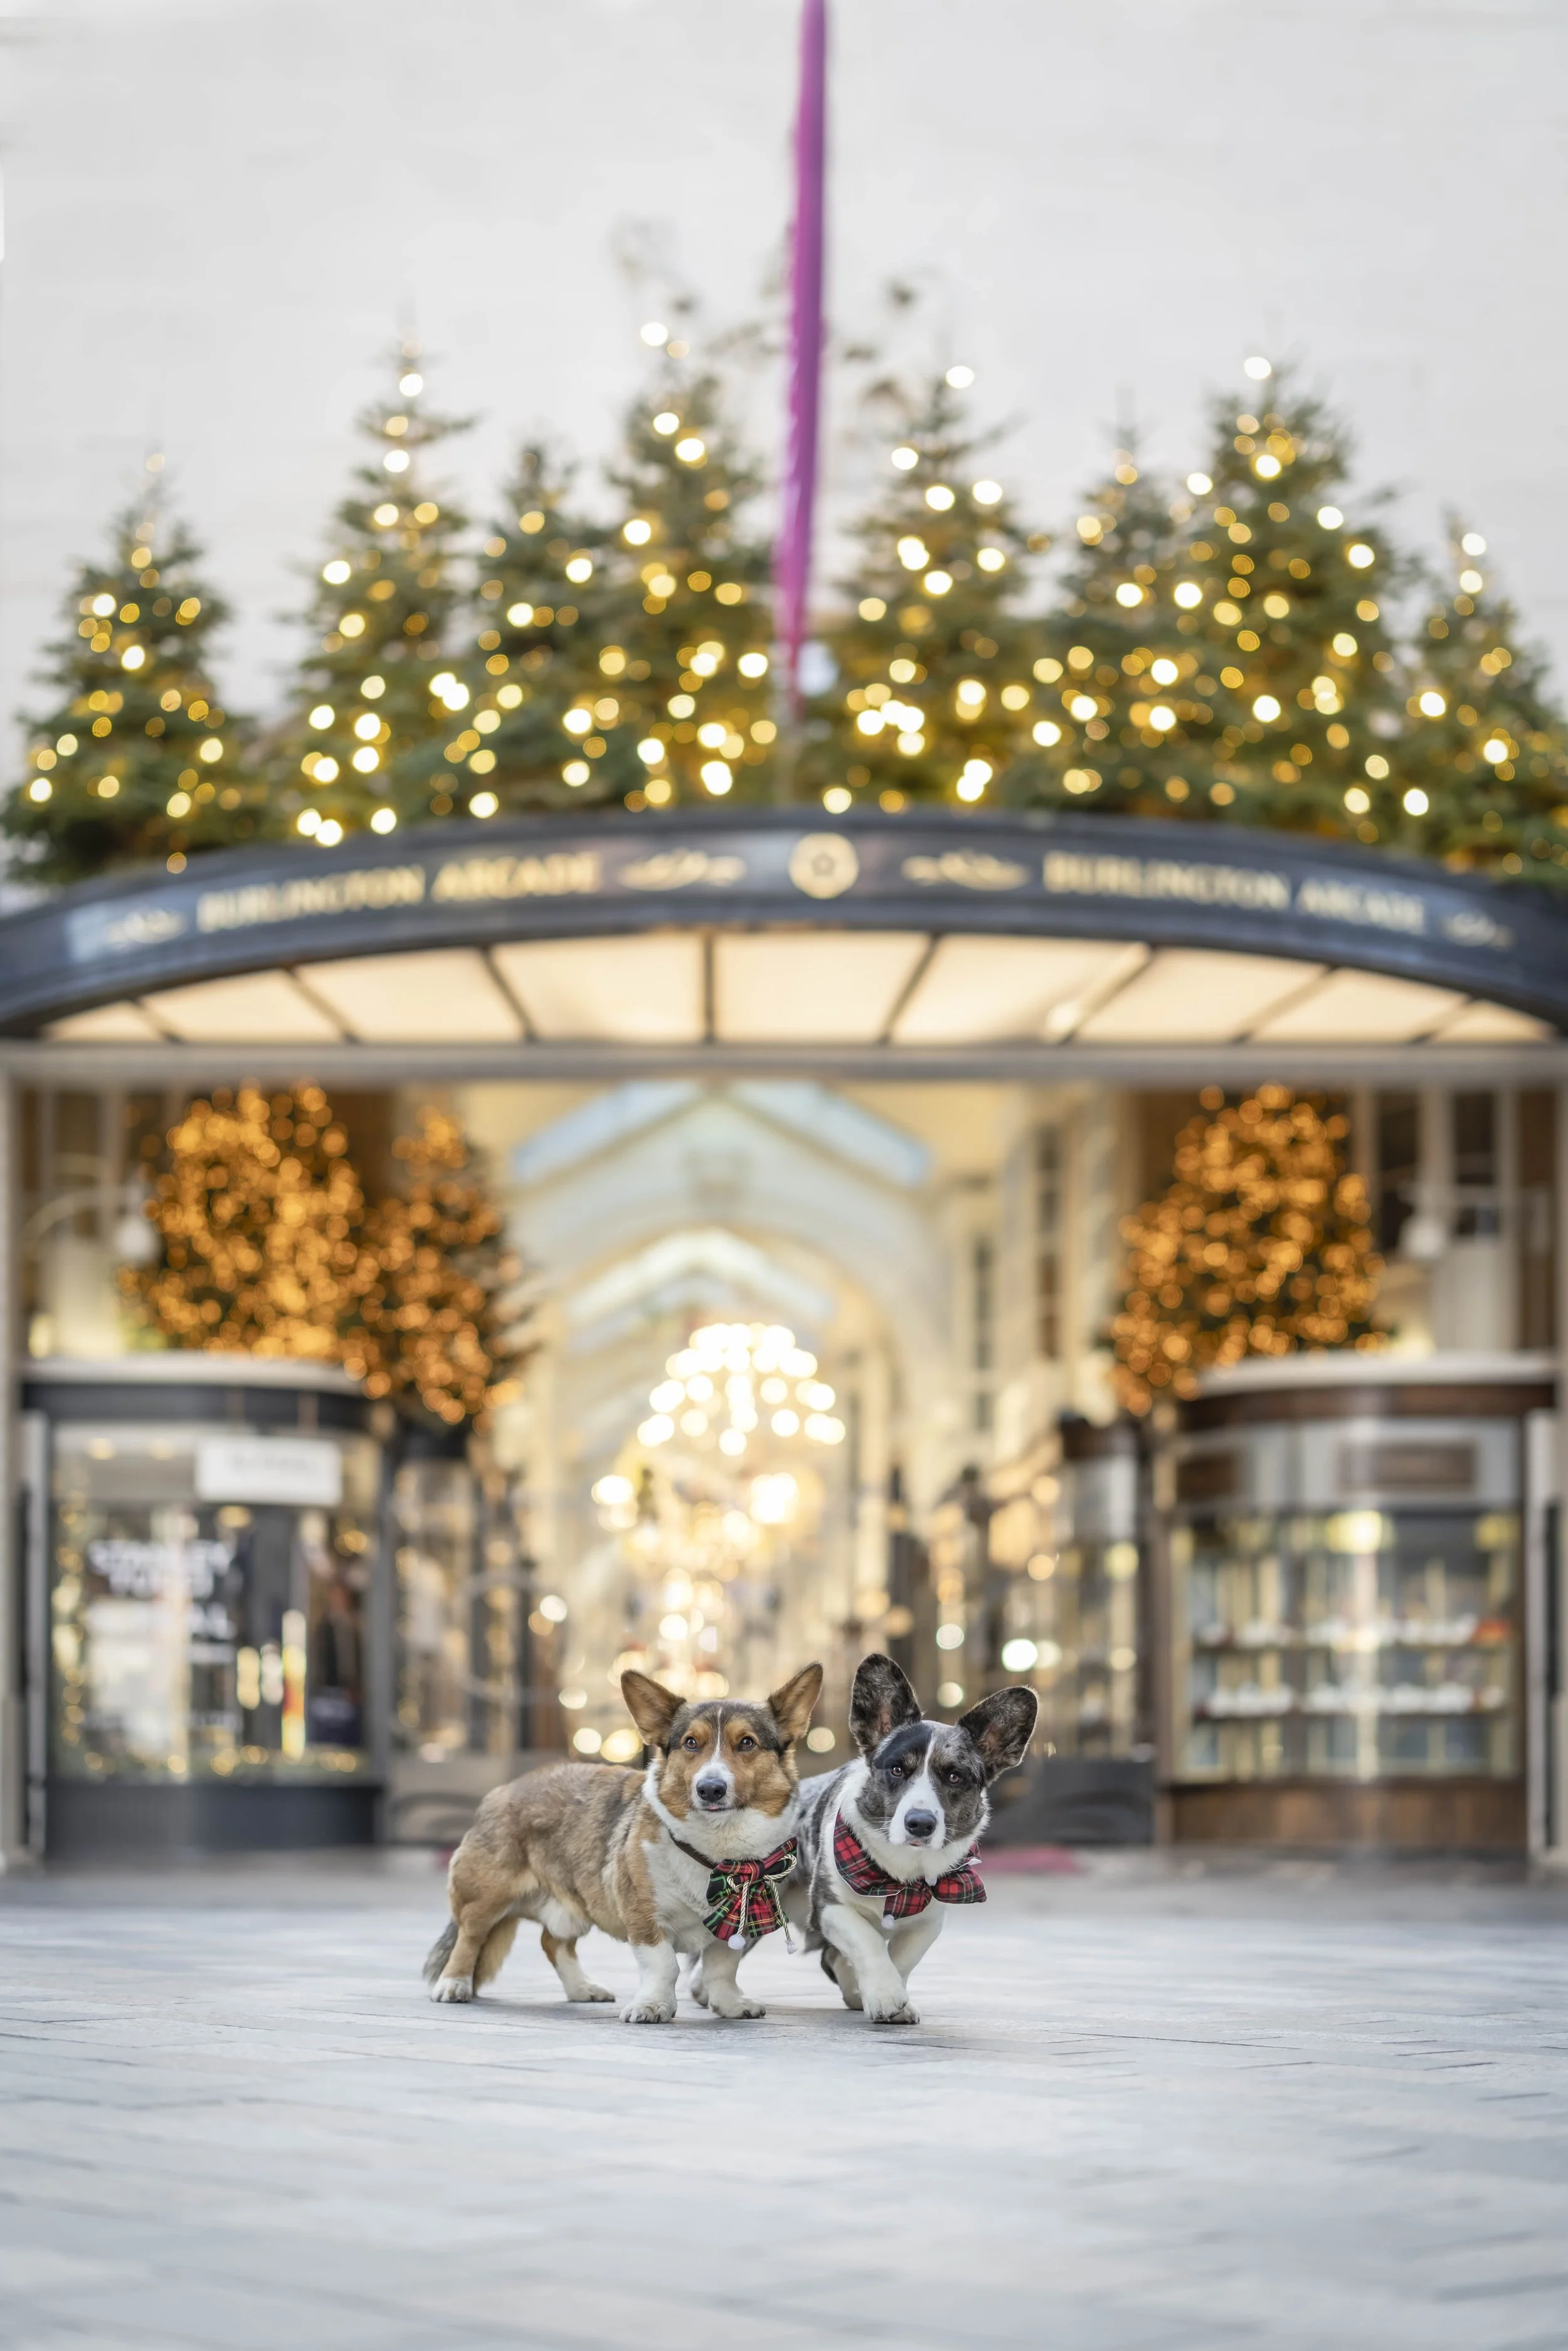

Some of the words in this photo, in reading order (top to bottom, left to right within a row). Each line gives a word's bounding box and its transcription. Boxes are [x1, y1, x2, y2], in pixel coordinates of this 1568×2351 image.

[197, 864, 425, 933] BURLINGTON
[431, 852, 602, 903] ARCADE
[1044, 851, 1291, 911] BURLINGTON
[1296, 878, 1426, 935] ARCADE
